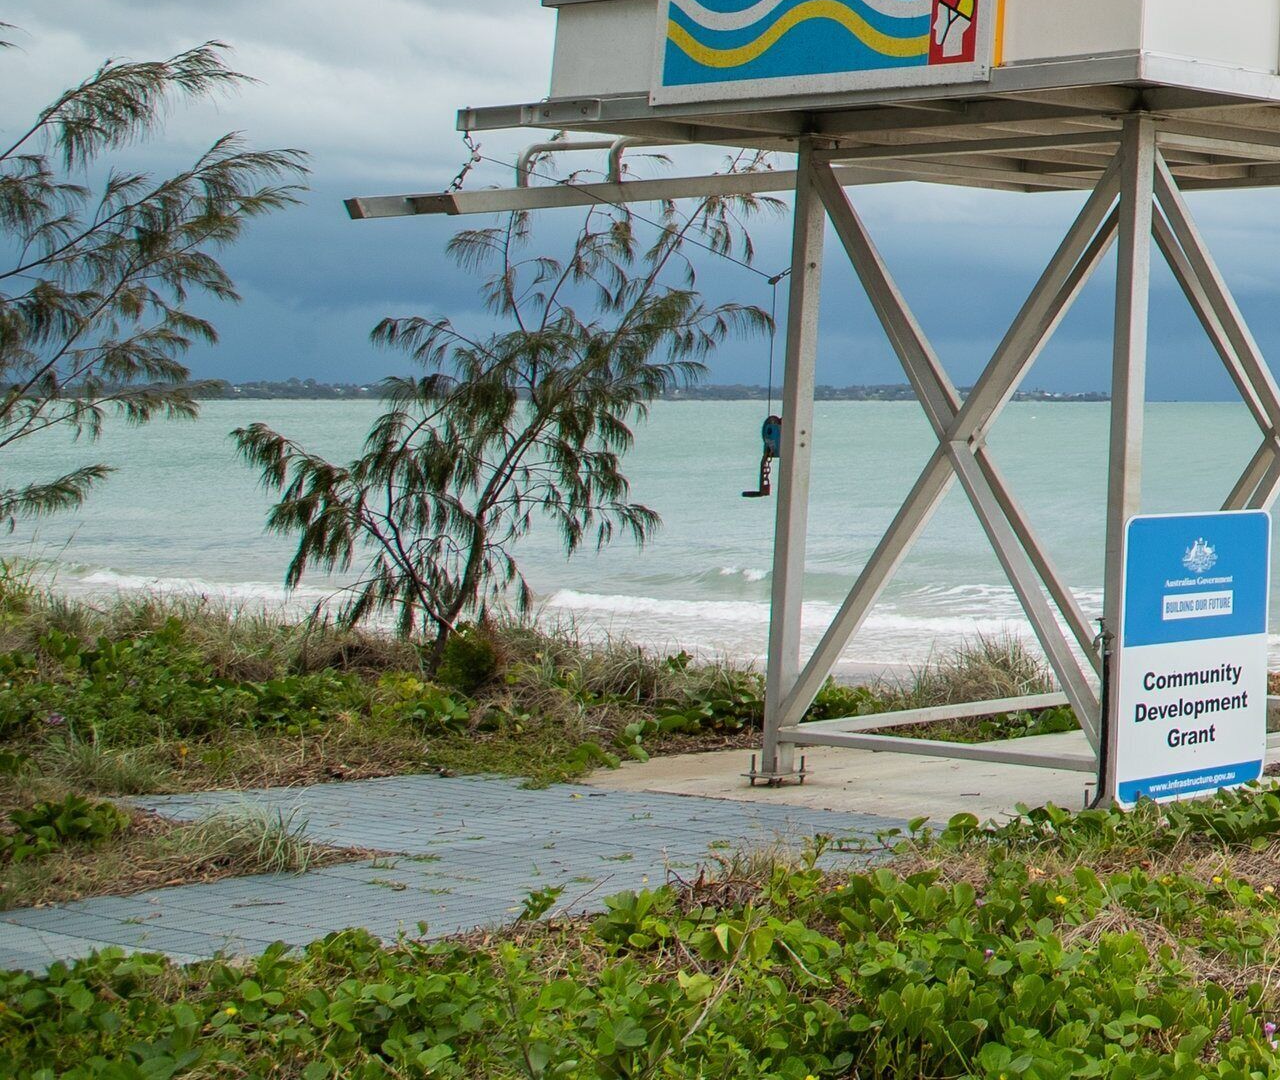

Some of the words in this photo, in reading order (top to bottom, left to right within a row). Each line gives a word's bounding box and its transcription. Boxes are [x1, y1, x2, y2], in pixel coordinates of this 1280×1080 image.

[1164, 577, 1196, 588] Australian
[1196, 575, 1233, 585] Government
[1165, 600, 1194, 614] BUILDING
[1195, 599, 1208, 611] OUR
[1208, 596, 1231, 610] FUTURE
[1143, 664, 1242, 691] Community
[1135, 690, 1248, 723] Development
[1167, 724, 1216, 748] Grant
[1149, 771, 1236, 793] www.infrastructure.gov.au
